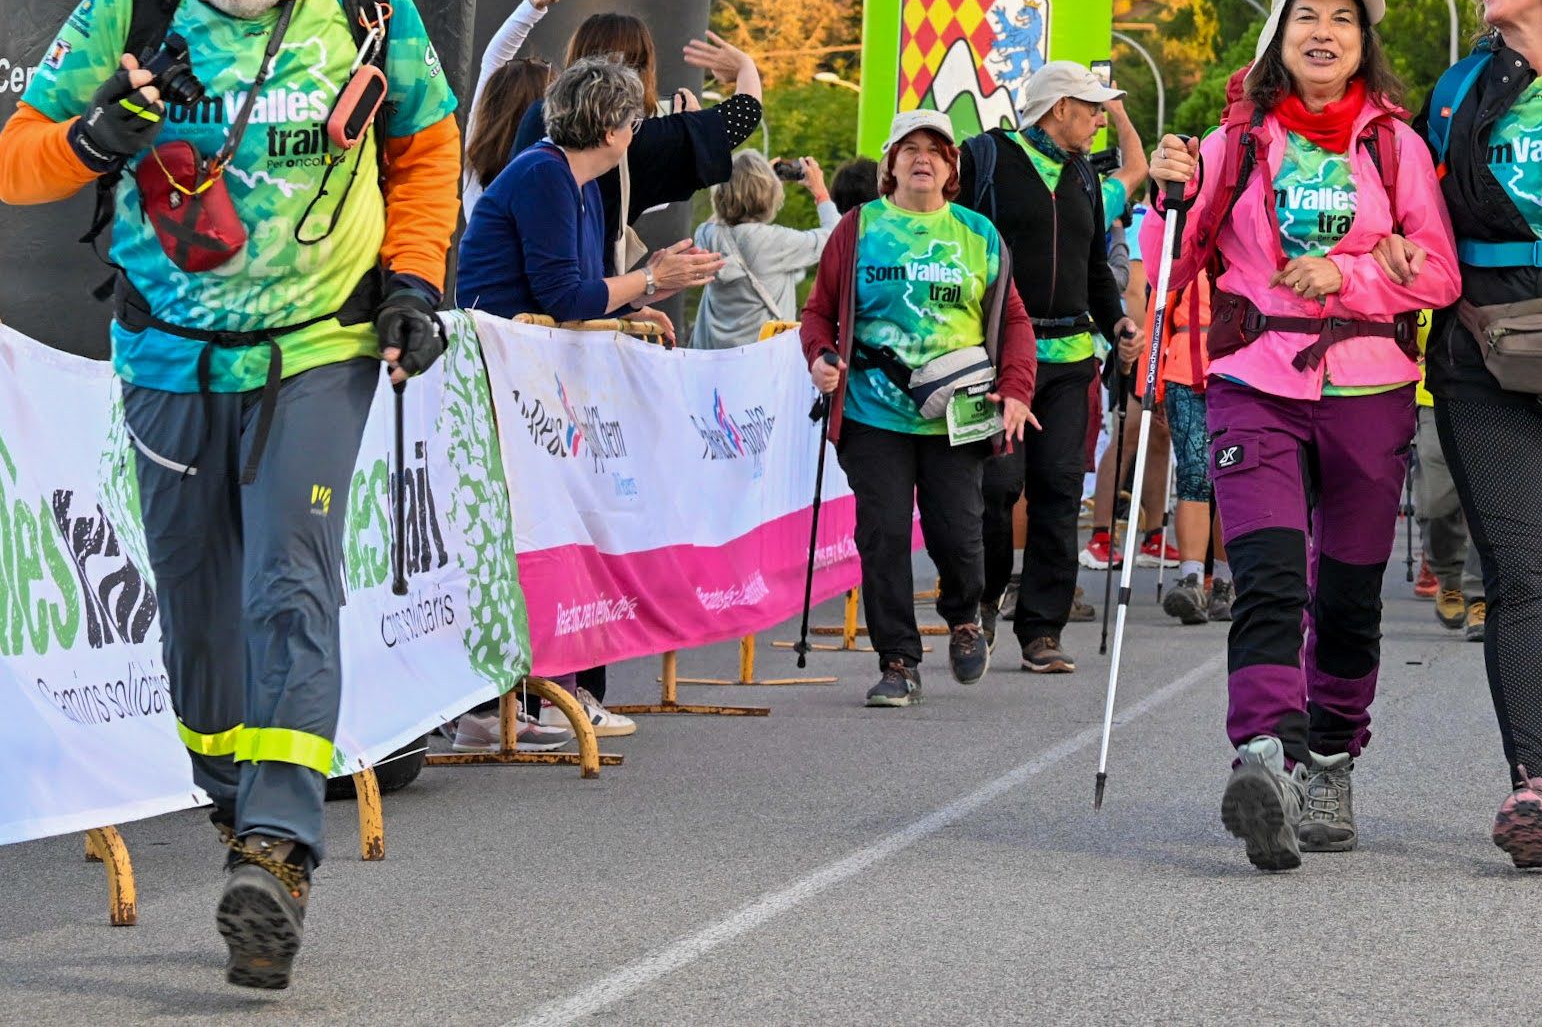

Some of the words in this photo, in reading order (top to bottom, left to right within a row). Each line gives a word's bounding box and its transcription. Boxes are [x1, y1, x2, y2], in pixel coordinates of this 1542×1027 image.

[865, 259, 963, 285] somVallès
[929, 283, 962, 303] trail
[1147, 342, 1158, 384] Quechua
